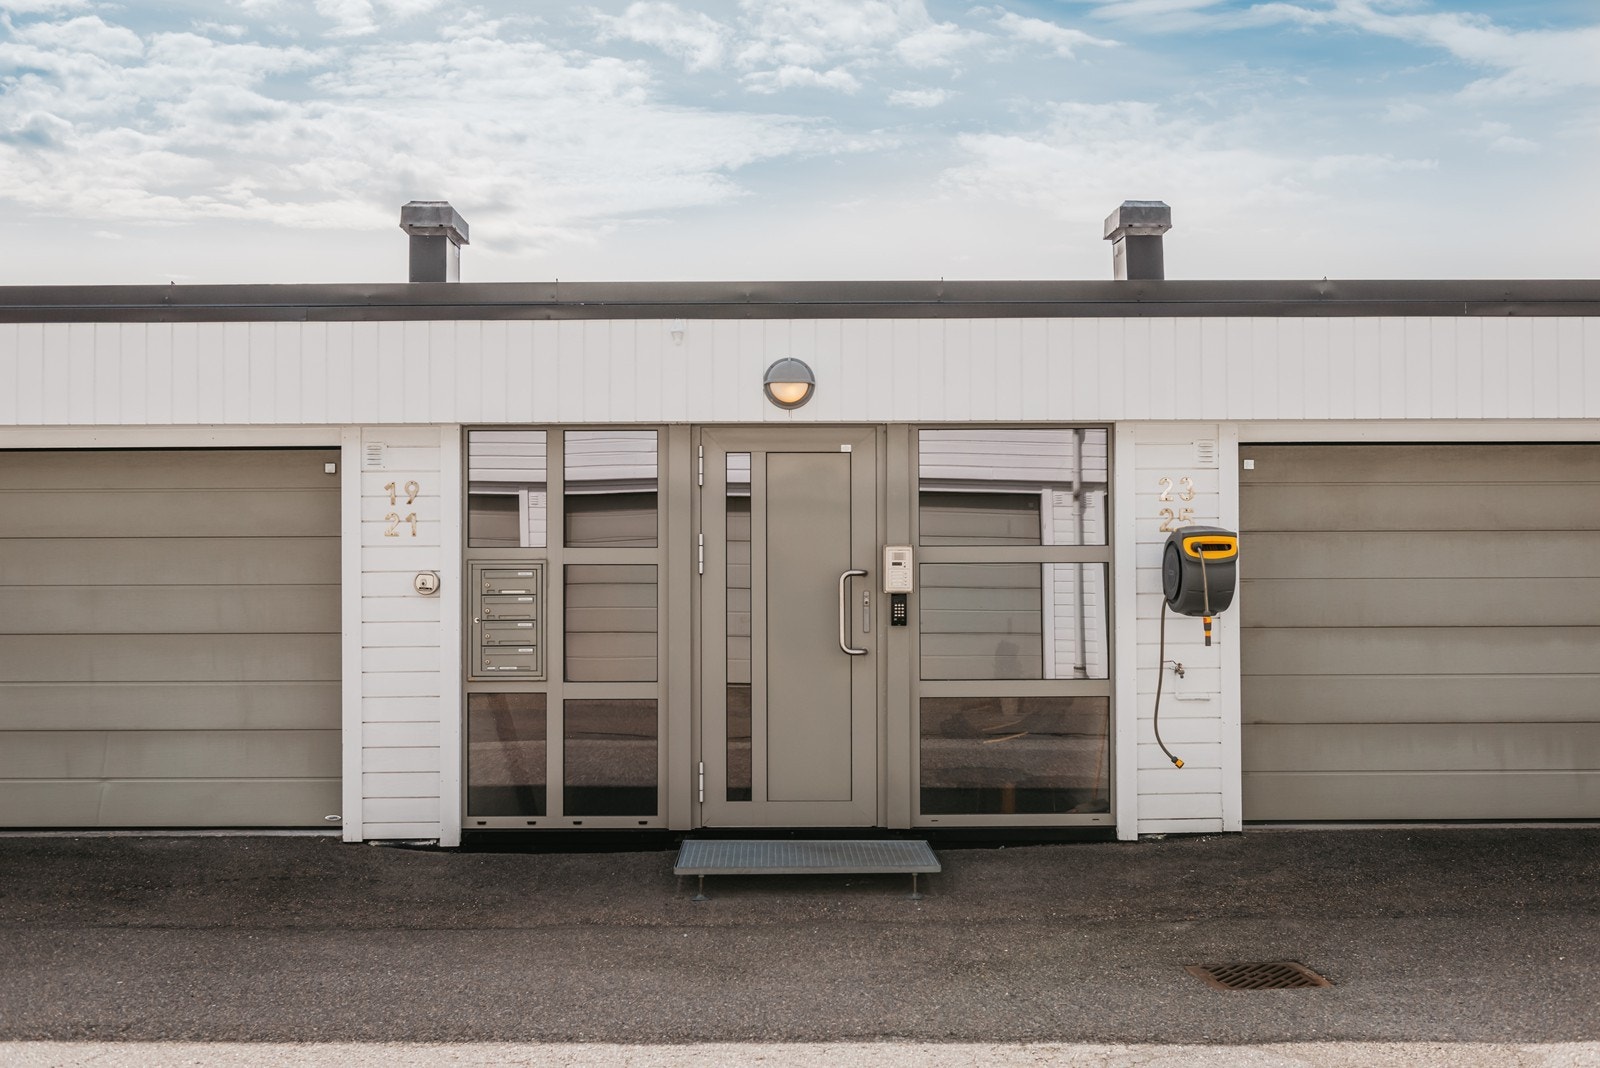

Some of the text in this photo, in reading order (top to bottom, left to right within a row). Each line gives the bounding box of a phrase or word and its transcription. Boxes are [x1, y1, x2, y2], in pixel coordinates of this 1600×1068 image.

[384, 480, 420, 506] 19
[1158, 476, 1195, 502] 23
[384, 512, 418, 537] 21
[1159, 508, 1195, 533] 25
